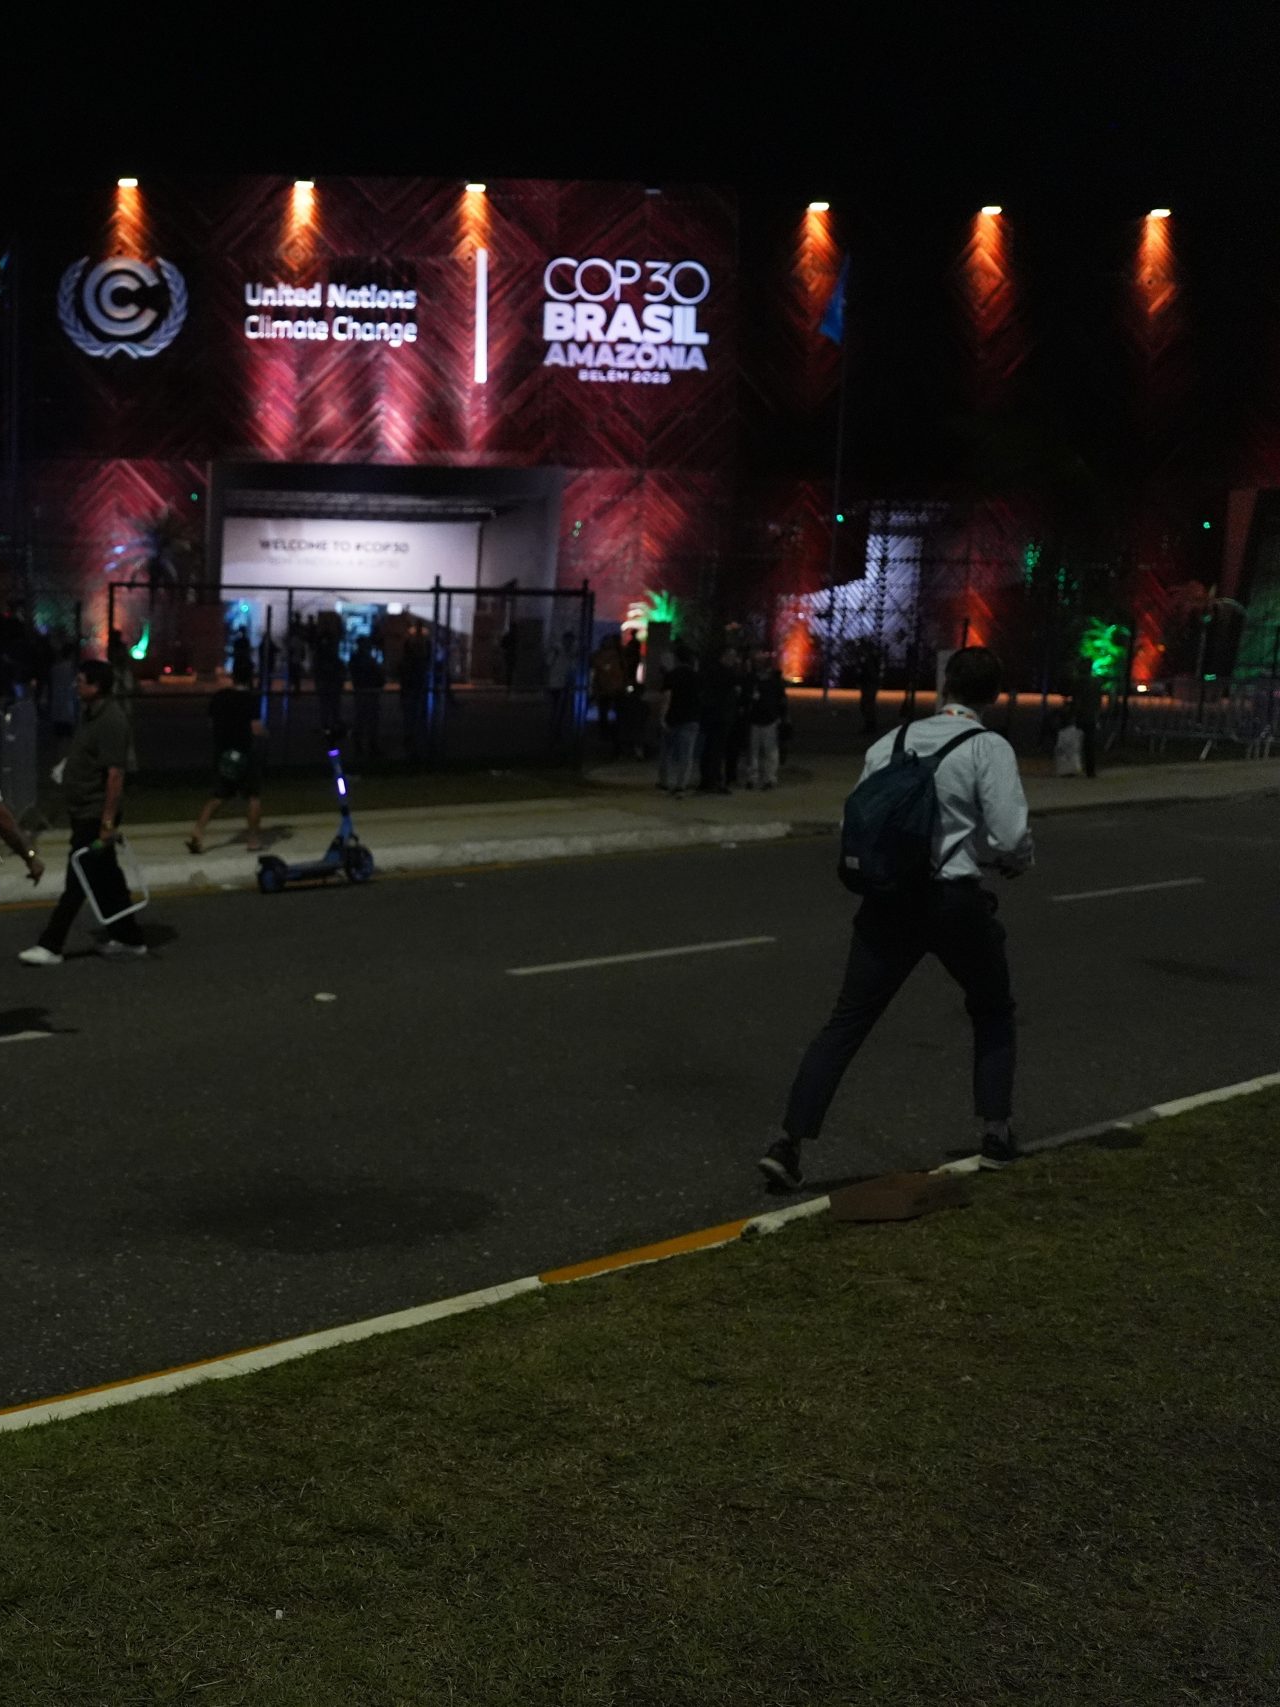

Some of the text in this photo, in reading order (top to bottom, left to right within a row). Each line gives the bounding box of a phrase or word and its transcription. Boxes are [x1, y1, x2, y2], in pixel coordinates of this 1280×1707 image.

[245, 282, 417, 309] United Nations
[244, 315, 417, 347] Climate Change
[543, 301, 709, 345] BRASIL
[259, 538, 327, 552] WELCOME
[332, 540, 351, 552] TO
